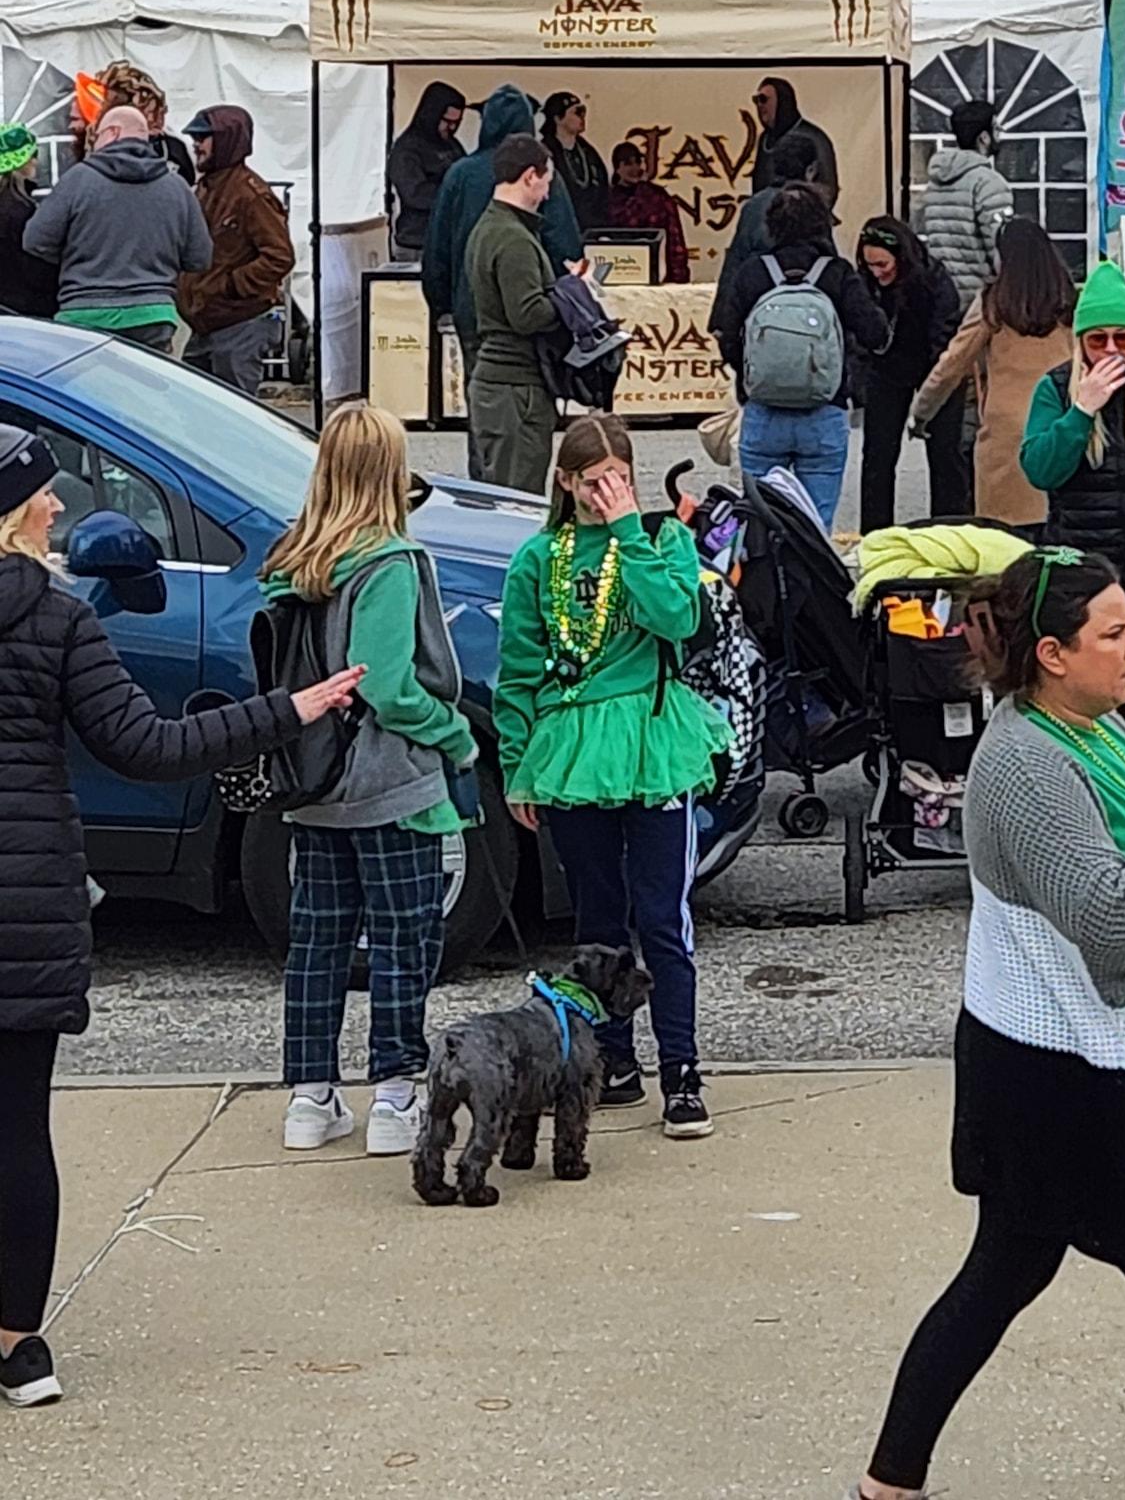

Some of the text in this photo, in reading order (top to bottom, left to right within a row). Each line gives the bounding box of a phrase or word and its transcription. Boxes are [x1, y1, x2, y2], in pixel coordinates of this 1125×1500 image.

[539, 16, 657, 37] MONSTER
[625, 108, 758, 190] JAV
[614, 308, 712, 356] AVA
[626, 355, 731, 382] NSTER
[658, 391, 728, 401] ENERGY
